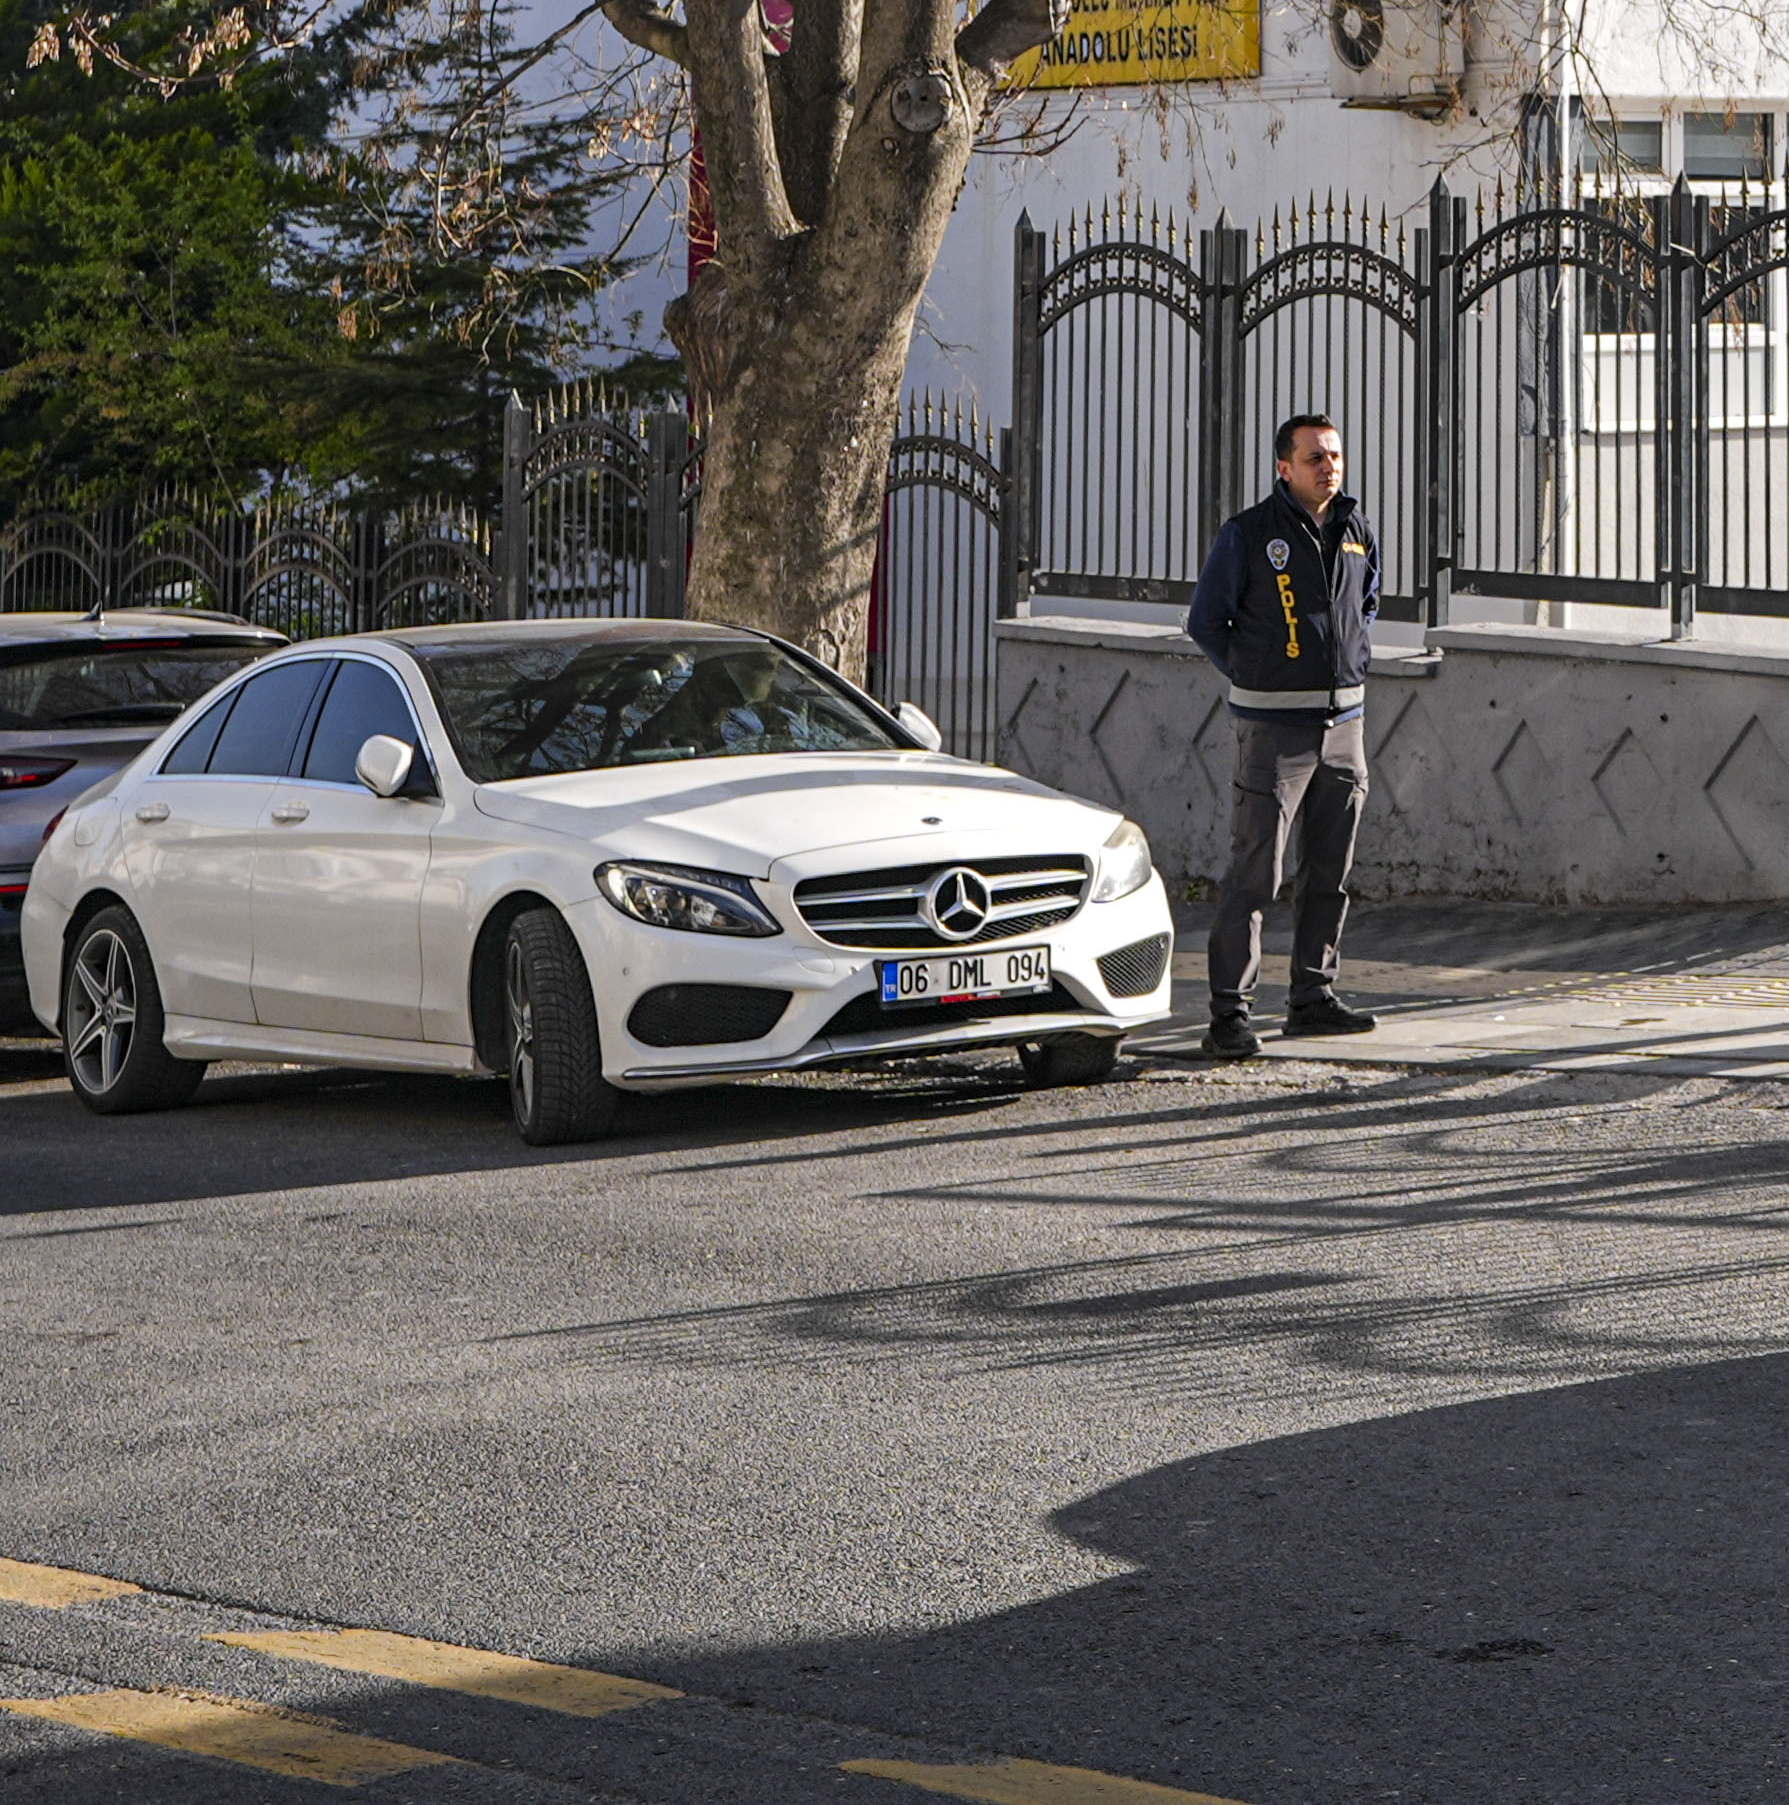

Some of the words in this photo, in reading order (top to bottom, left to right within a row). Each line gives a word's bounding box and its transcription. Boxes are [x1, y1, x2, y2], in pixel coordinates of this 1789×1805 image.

[1042, 30, 1130, 66] ANADOLU
[900, 964, 928, 994] 06
[950, 958, 992, 990] DML
[1008, 952, 1047, 983] 094
